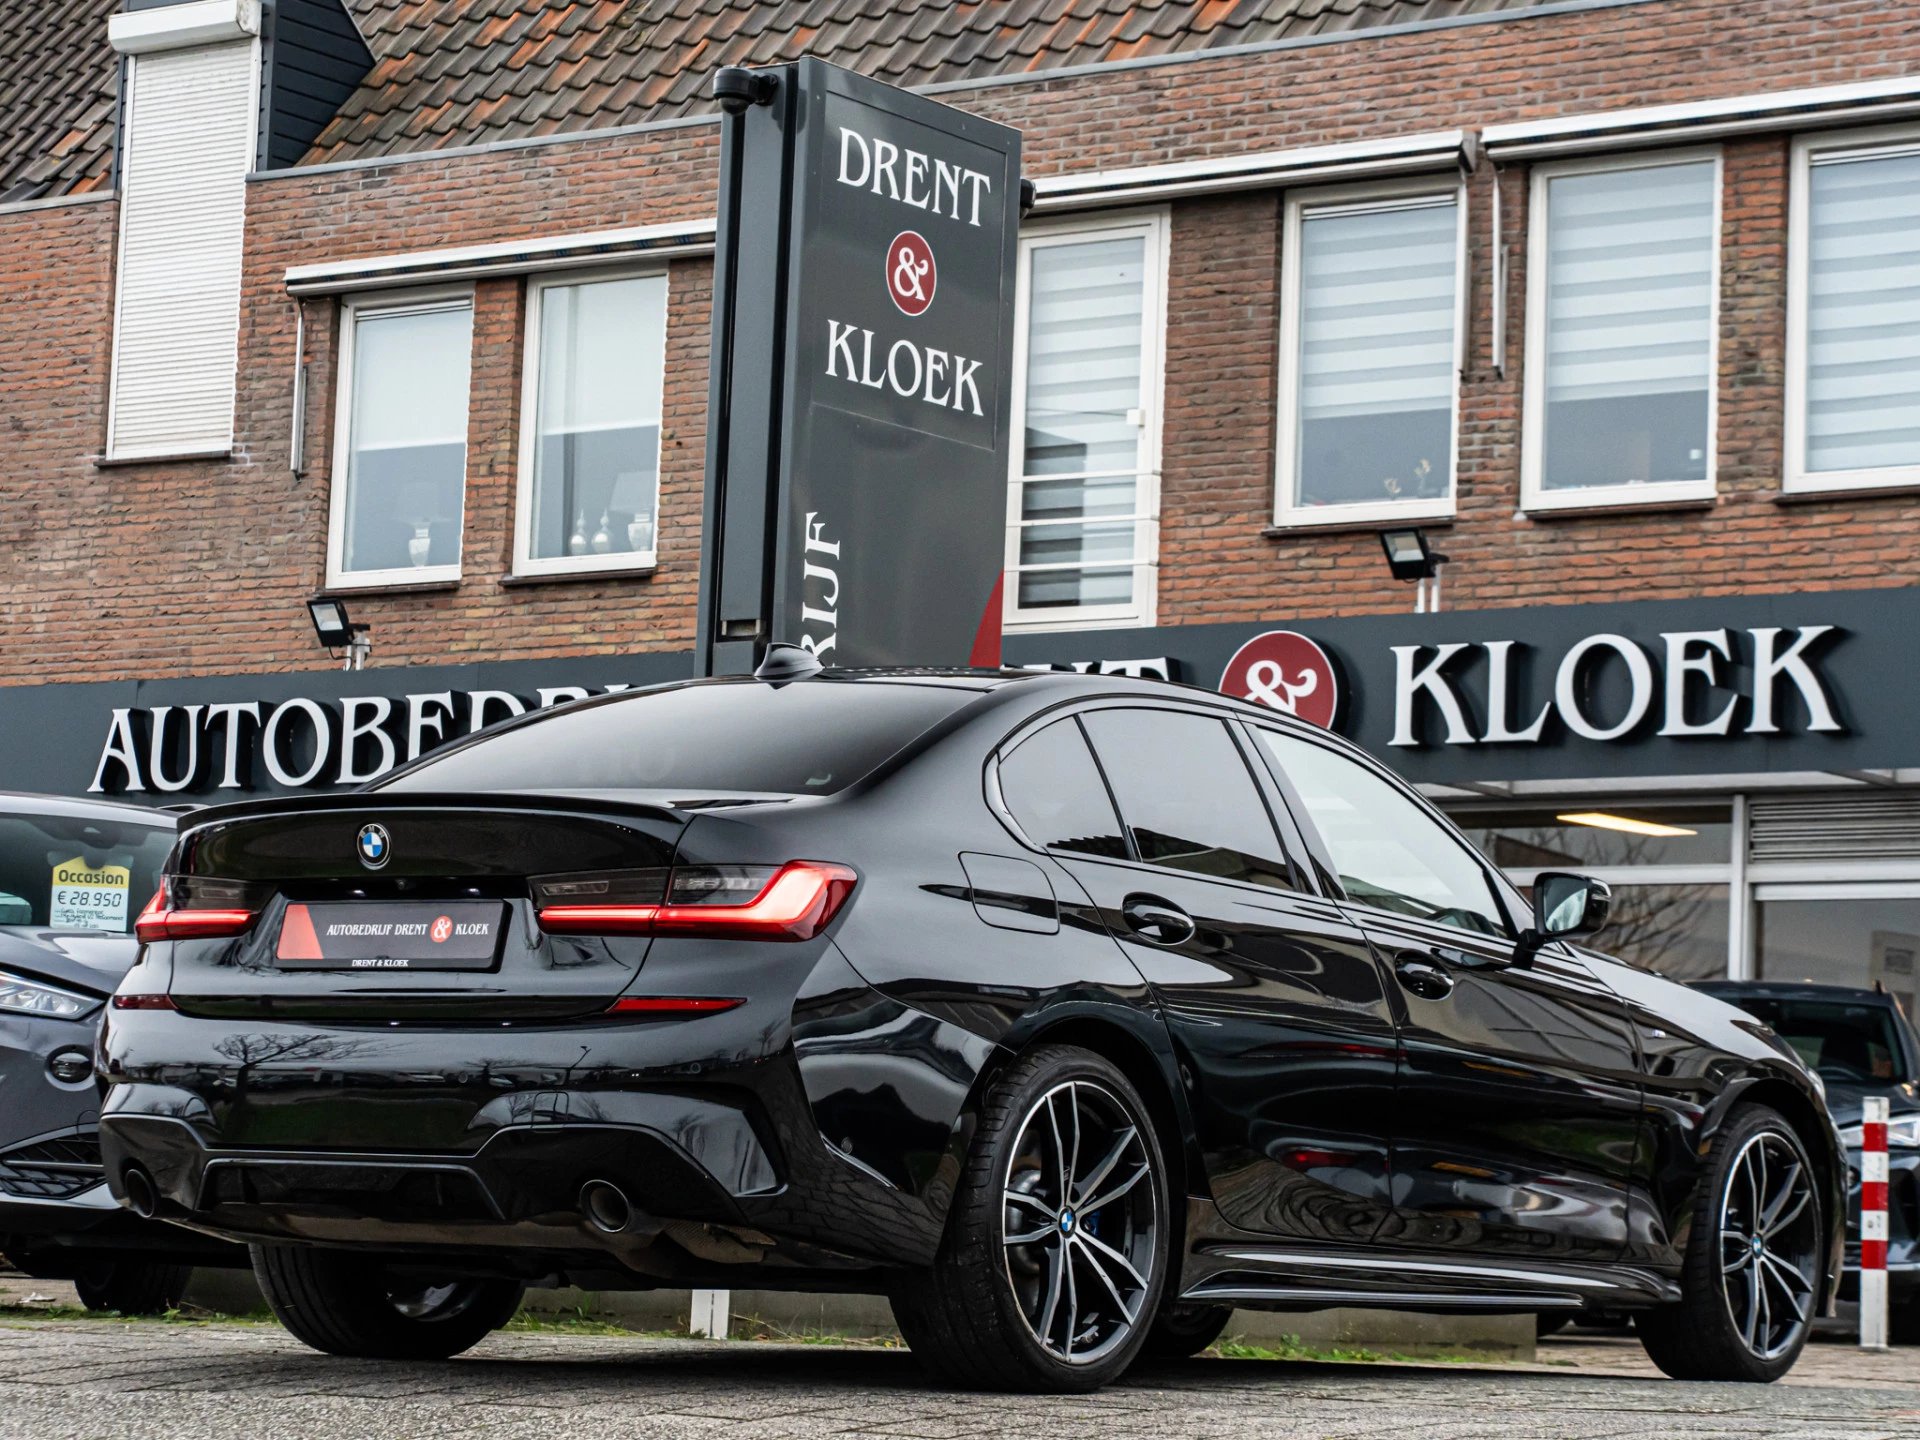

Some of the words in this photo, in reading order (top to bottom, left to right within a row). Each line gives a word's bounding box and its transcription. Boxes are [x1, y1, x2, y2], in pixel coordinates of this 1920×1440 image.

[836, 126, 991, 227] DRENT
[894, 246, 928, 301] &
[825, 319, 984, 417] KLOEK
[801, 511, 841, 668] RIJF
[1242, 660, 1318, 717] &
[1387, 625, 1843, 746] KLOEK
[58, 869, 124, 885] Occasion
[69, 891, 122, 907] 28.950
[326, 923, 393, 936] AUTOBEDRIJF
[394, 923, 428, 936] DRENT
[433, 918, 451, 939] &
[454, 923, 489, 935] KLOEK
[351, 959, 377, 967] DRENT
[376, 959, 383, 967] &
[383, 959, 409, 967] KLOEK
